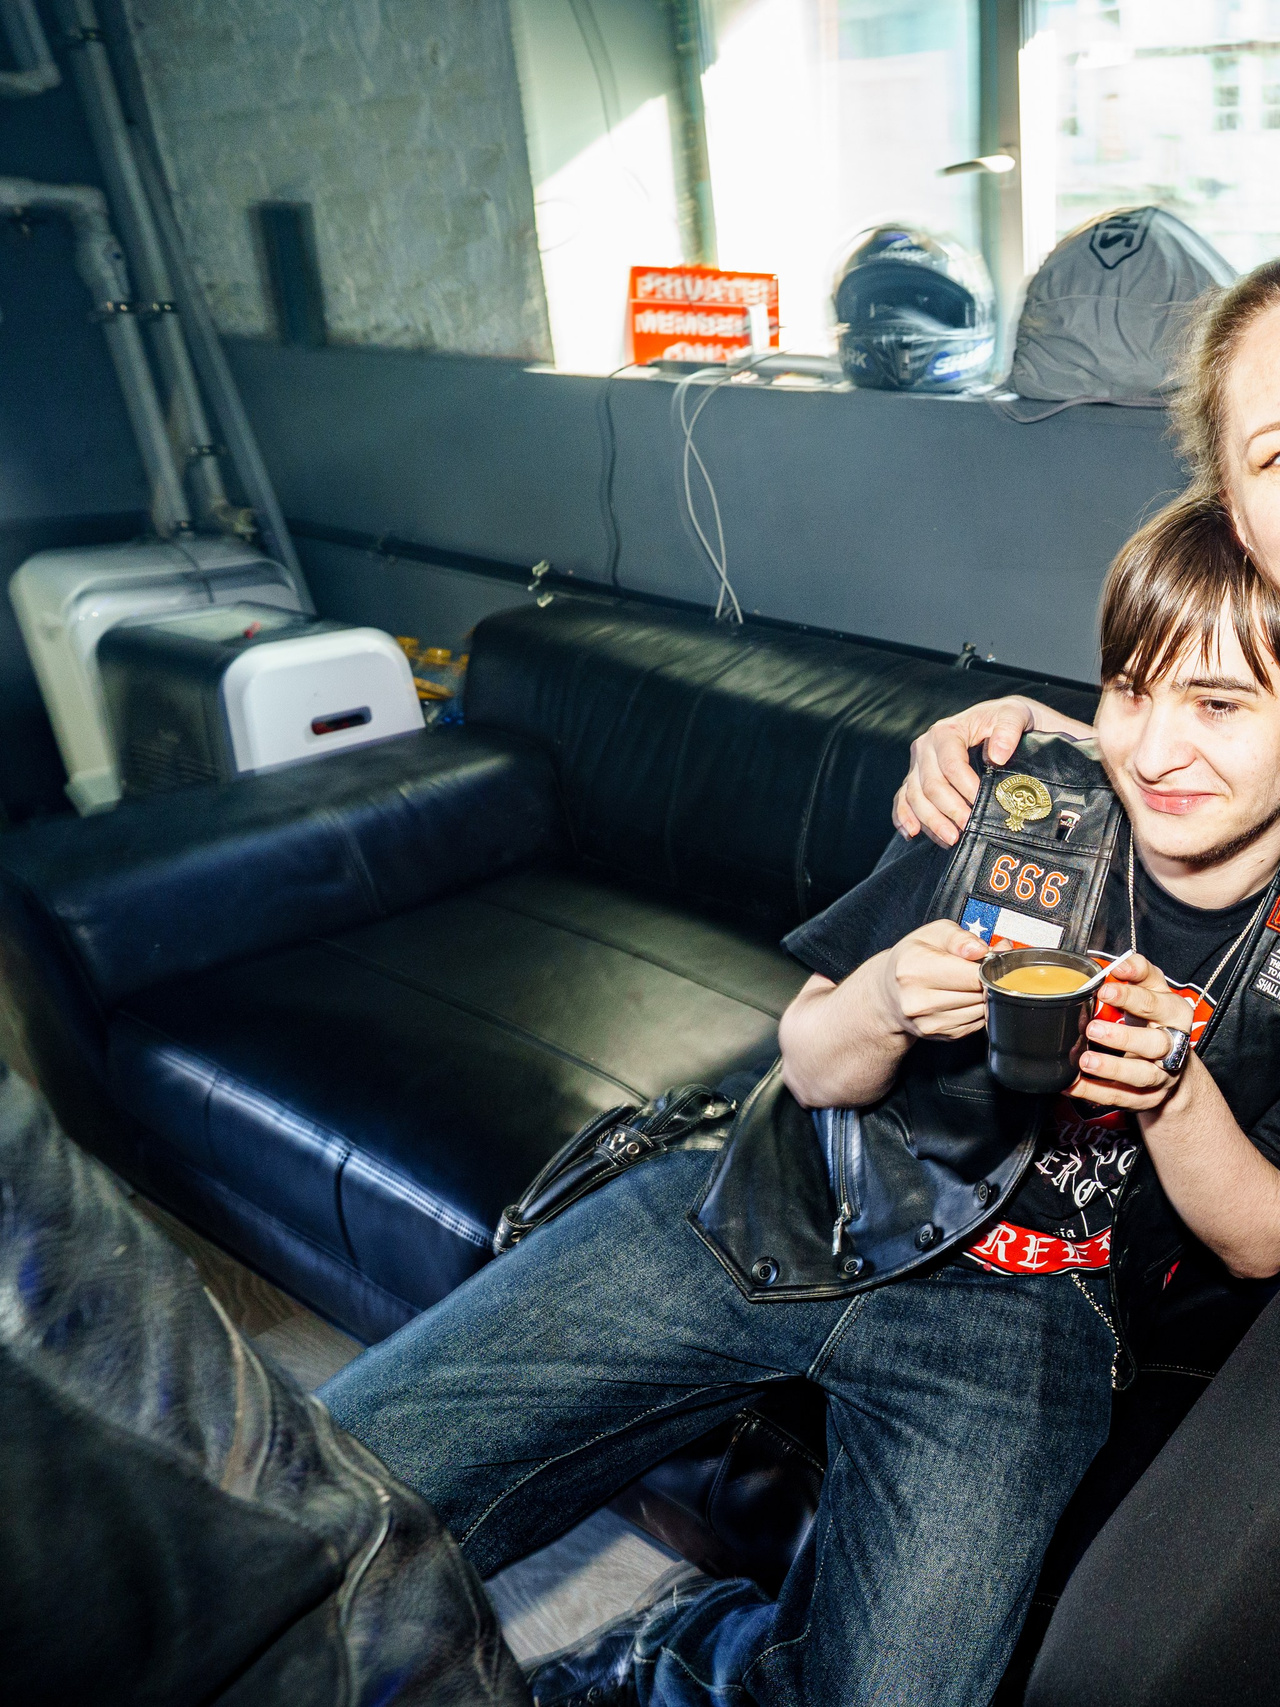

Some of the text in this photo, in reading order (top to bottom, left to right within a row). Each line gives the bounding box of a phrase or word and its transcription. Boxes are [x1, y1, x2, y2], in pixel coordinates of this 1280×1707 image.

[636, 272, 776, 305] PRIVATE
[635, 308, 778, 337] MEMBE
[989, 854, 1069, 908] 666
[1267, 966, 1277, 976] TO
[1256, 977, 1278, 999] SHALL
